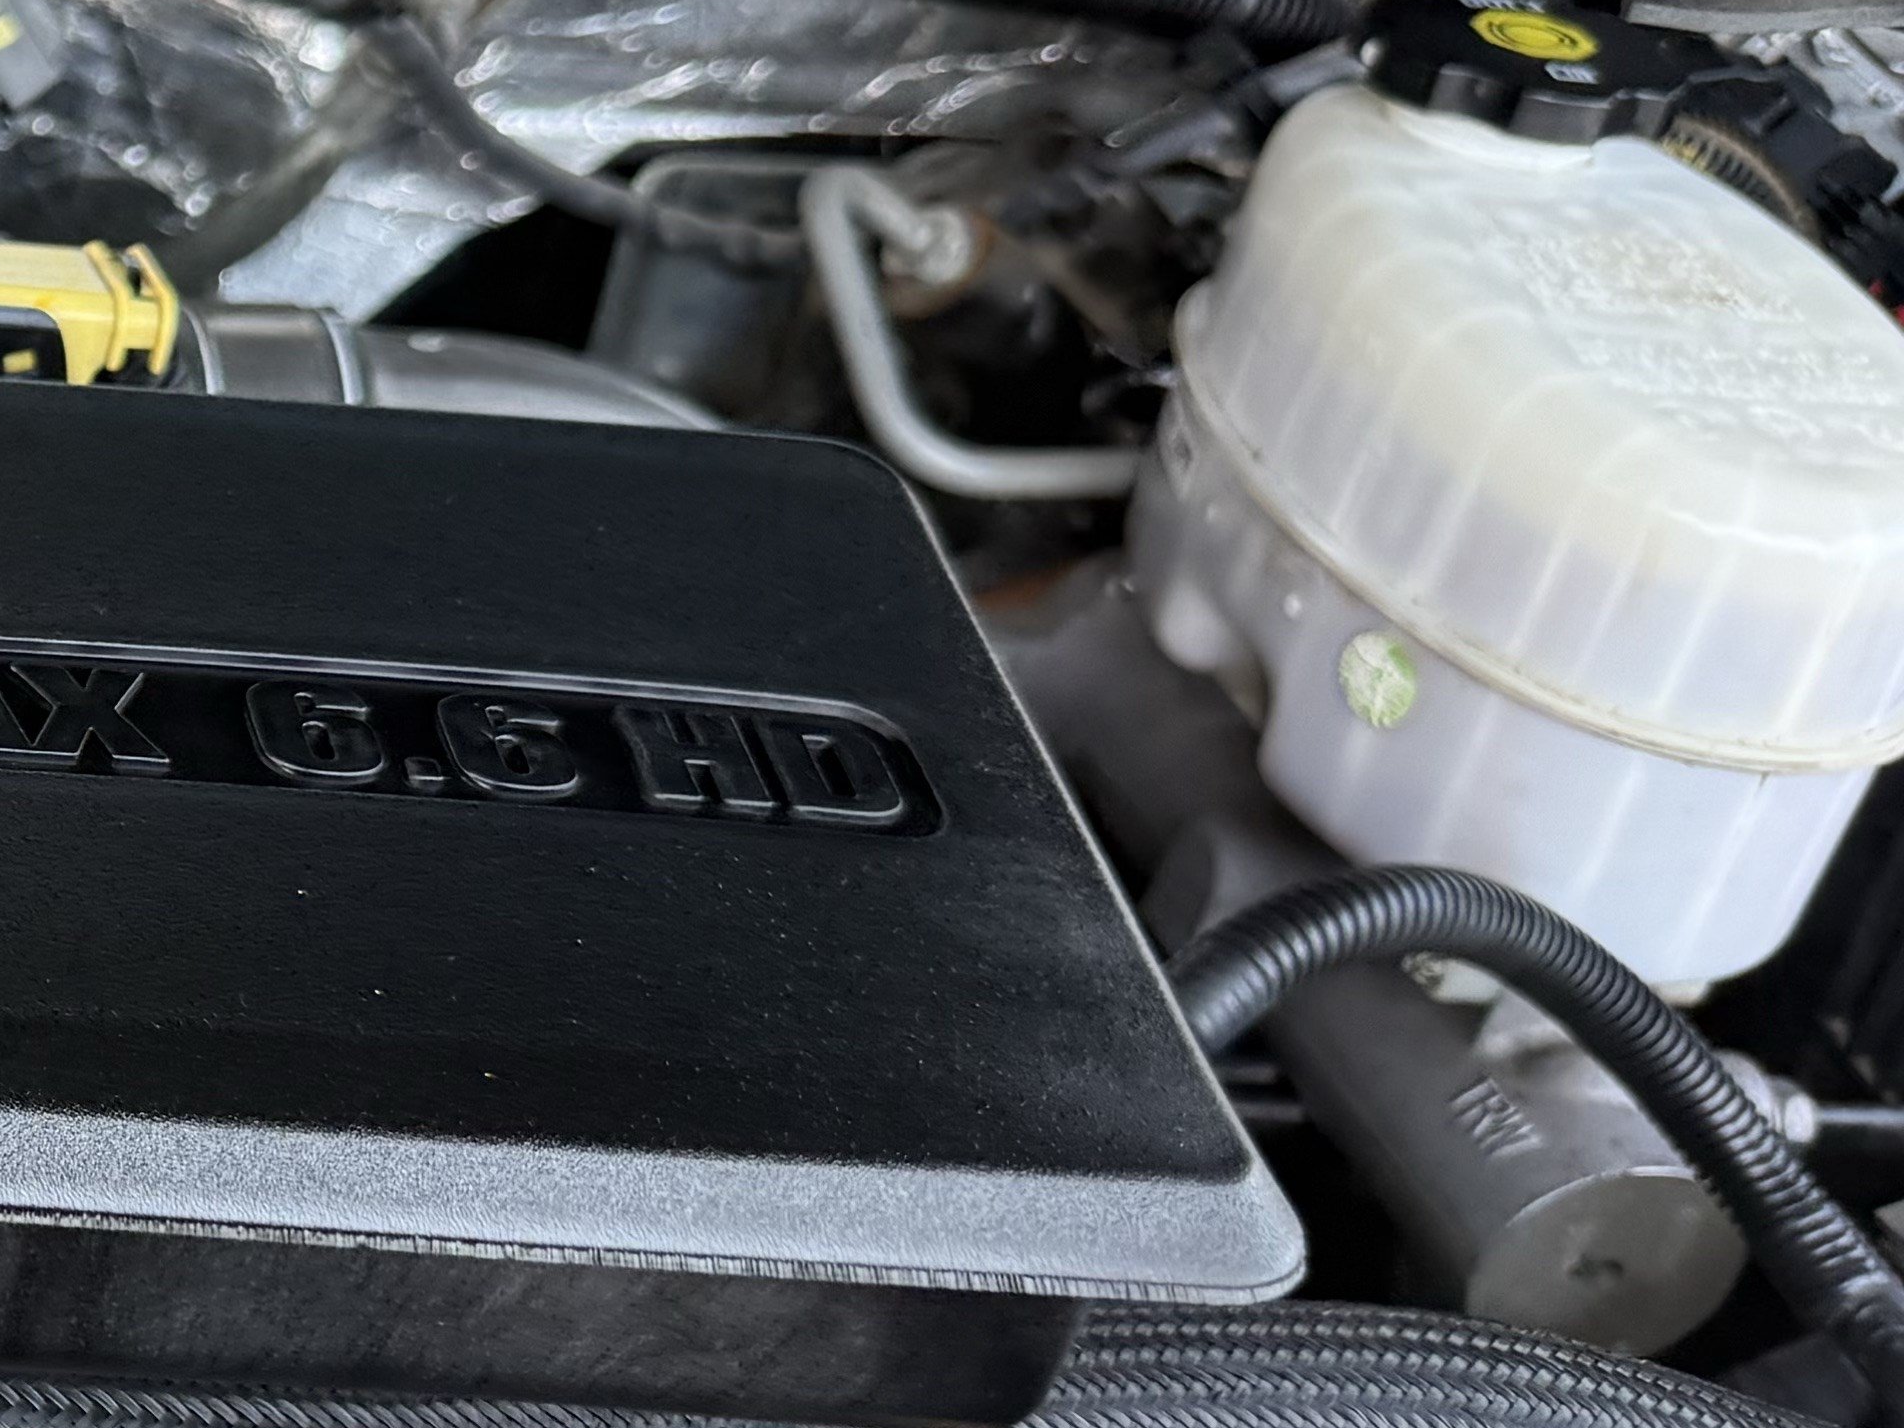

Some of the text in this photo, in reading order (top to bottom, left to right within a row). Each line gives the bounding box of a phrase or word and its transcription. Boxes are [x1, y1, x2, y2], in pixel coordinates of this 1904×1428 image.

[243, 679, 579, 800] 6.6
[612, 703, 908, 825] HD
[1446, 1075, 1545, 1159] TRW
